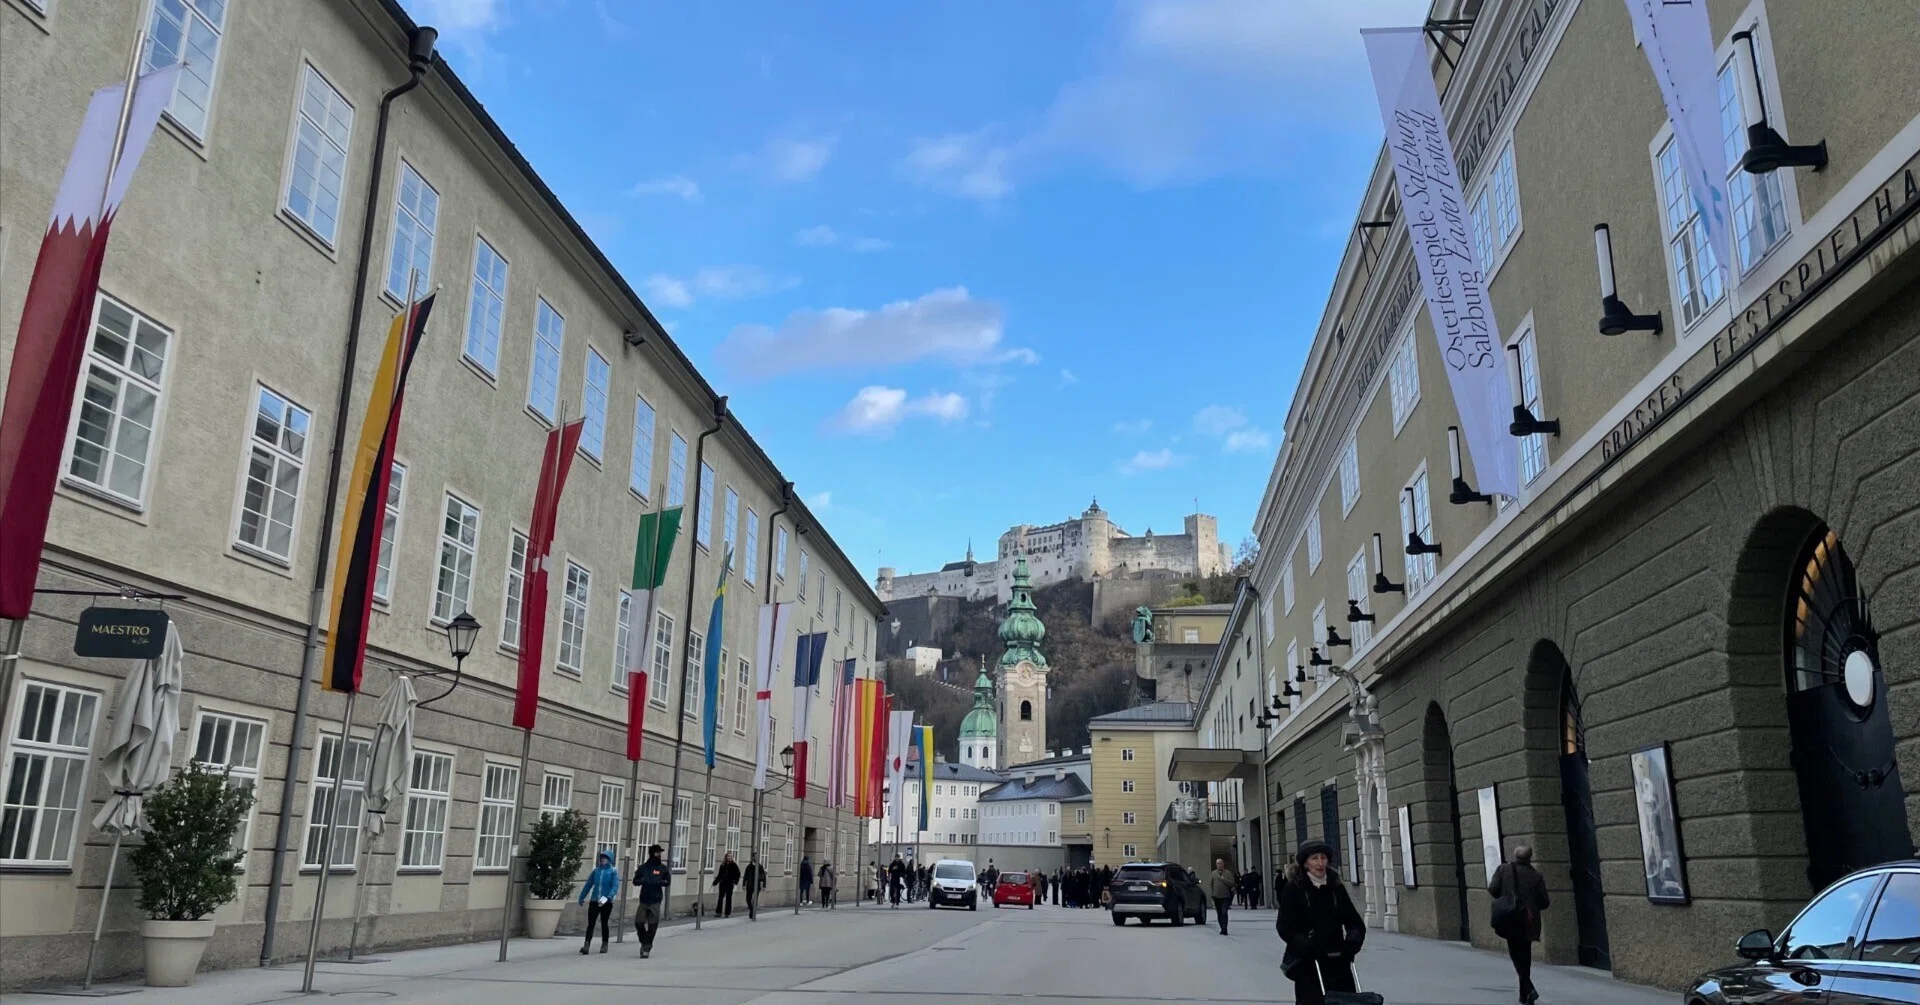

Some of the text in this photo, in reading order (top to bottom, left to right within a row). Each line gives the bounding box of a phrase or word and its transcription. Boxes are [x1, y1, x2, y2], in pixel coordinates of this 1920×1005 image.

[1394, 110, 1466, 371] Osterfestspiele Salzburg
[1410, 109, 1495, 369] Salzburg Easter Festival
[1602, 375, 1683, 462] GROSSES
[91, 624, 150, 636] MAESTRO
